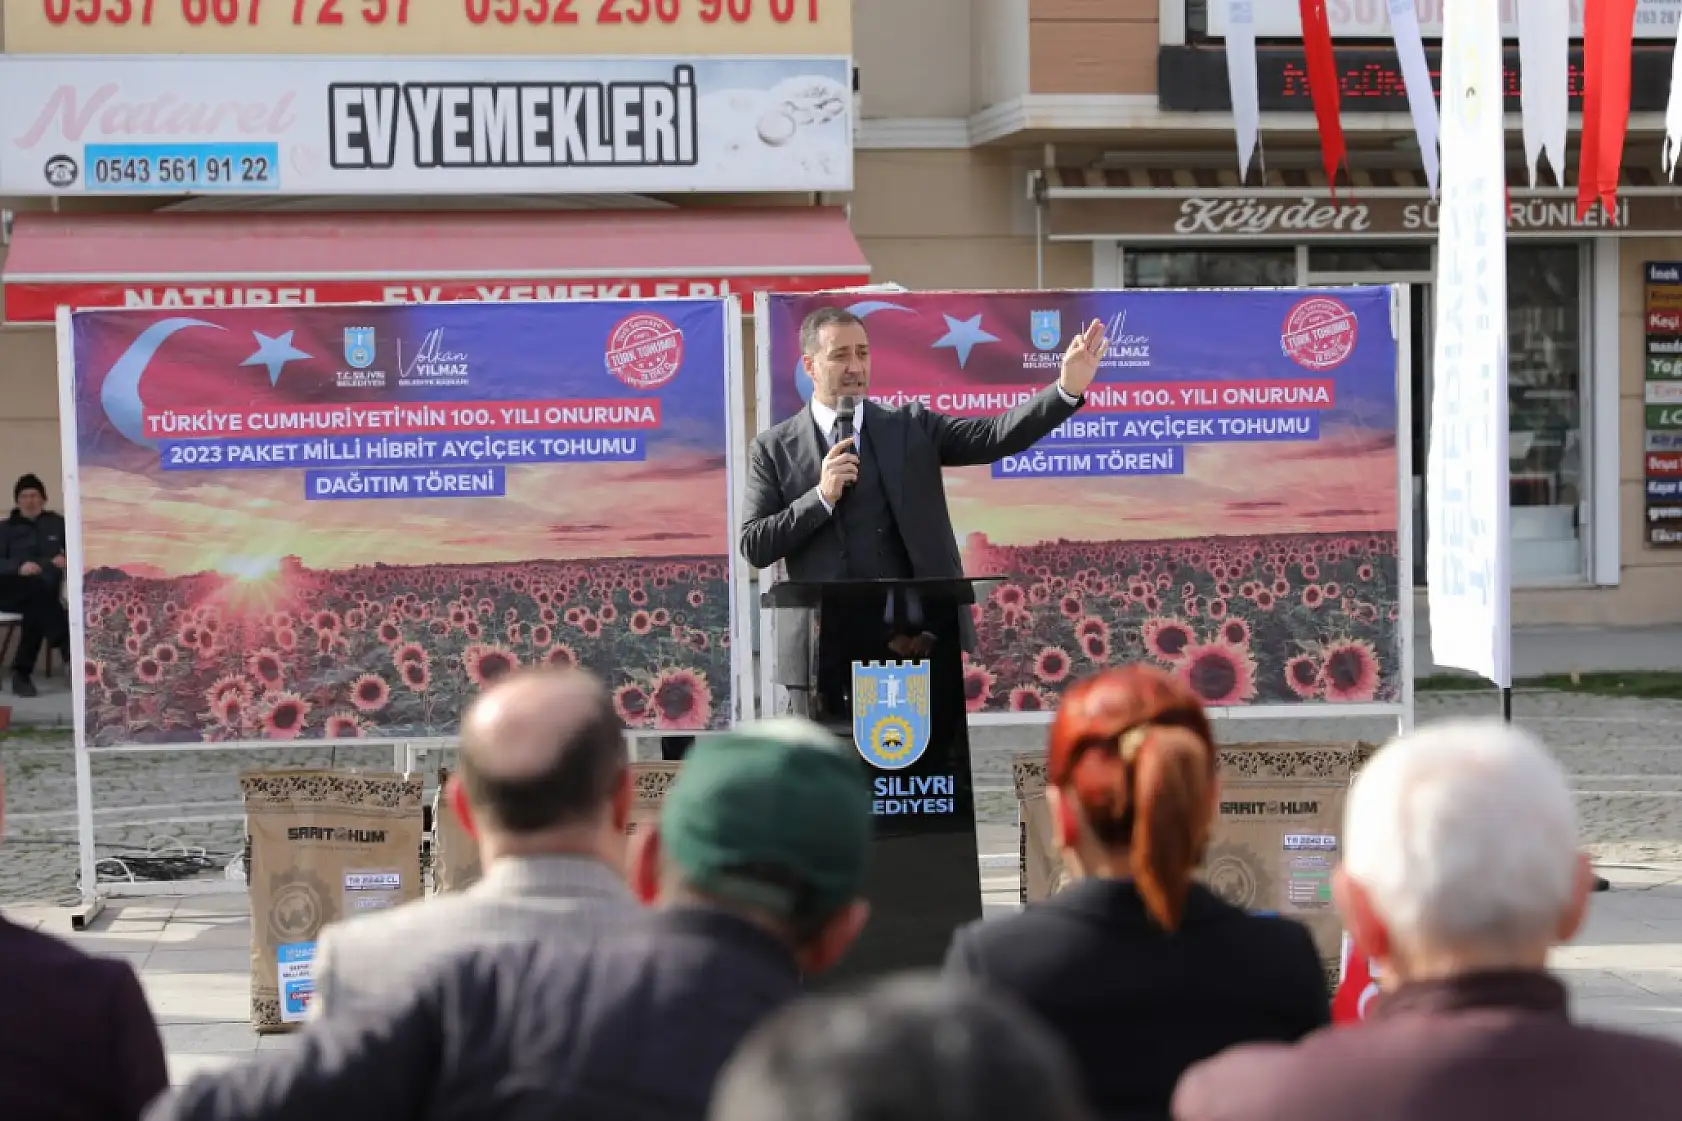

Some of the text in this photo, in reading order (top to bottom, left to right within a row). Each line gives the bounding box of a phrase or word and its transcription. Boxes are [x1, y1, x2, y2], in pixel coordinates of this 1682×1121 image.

[13, 82, 297, 148] Naturel
[95, 156, 268, 183] 0543 561 91 22
[1175, 197, 1371, 233] Köyden
[1403, 198, 1629, 228] SÜ RÜNLERİ
[416, 364, 469, 376] YILMAZ
[1131, 389, 1175, 407] 100.
[1180, 388, 1218, 406] YILI
[1223, 386, 1330, 405] ONURUNA
[148, 405, 656, 432] TÜRKİYE CUMHURİYETİ'NİN 100. YILI ONURUNA
[1123, 415, 1214, 439] AYÇİÇEK
[1218, 417, 1311, 435] TOHUMU
[171, 435, 637, 464] 2023 PAKET MİLLİ HİBRİT AYÇİÇEK TOHUMU
[1001, 448, 1173, 473] DAĞITIM TÖRENİ
[316, 469, 494, 494] DAĞITIM TÖRENİ
[872, 797, 954, 815] EDİYESİ
